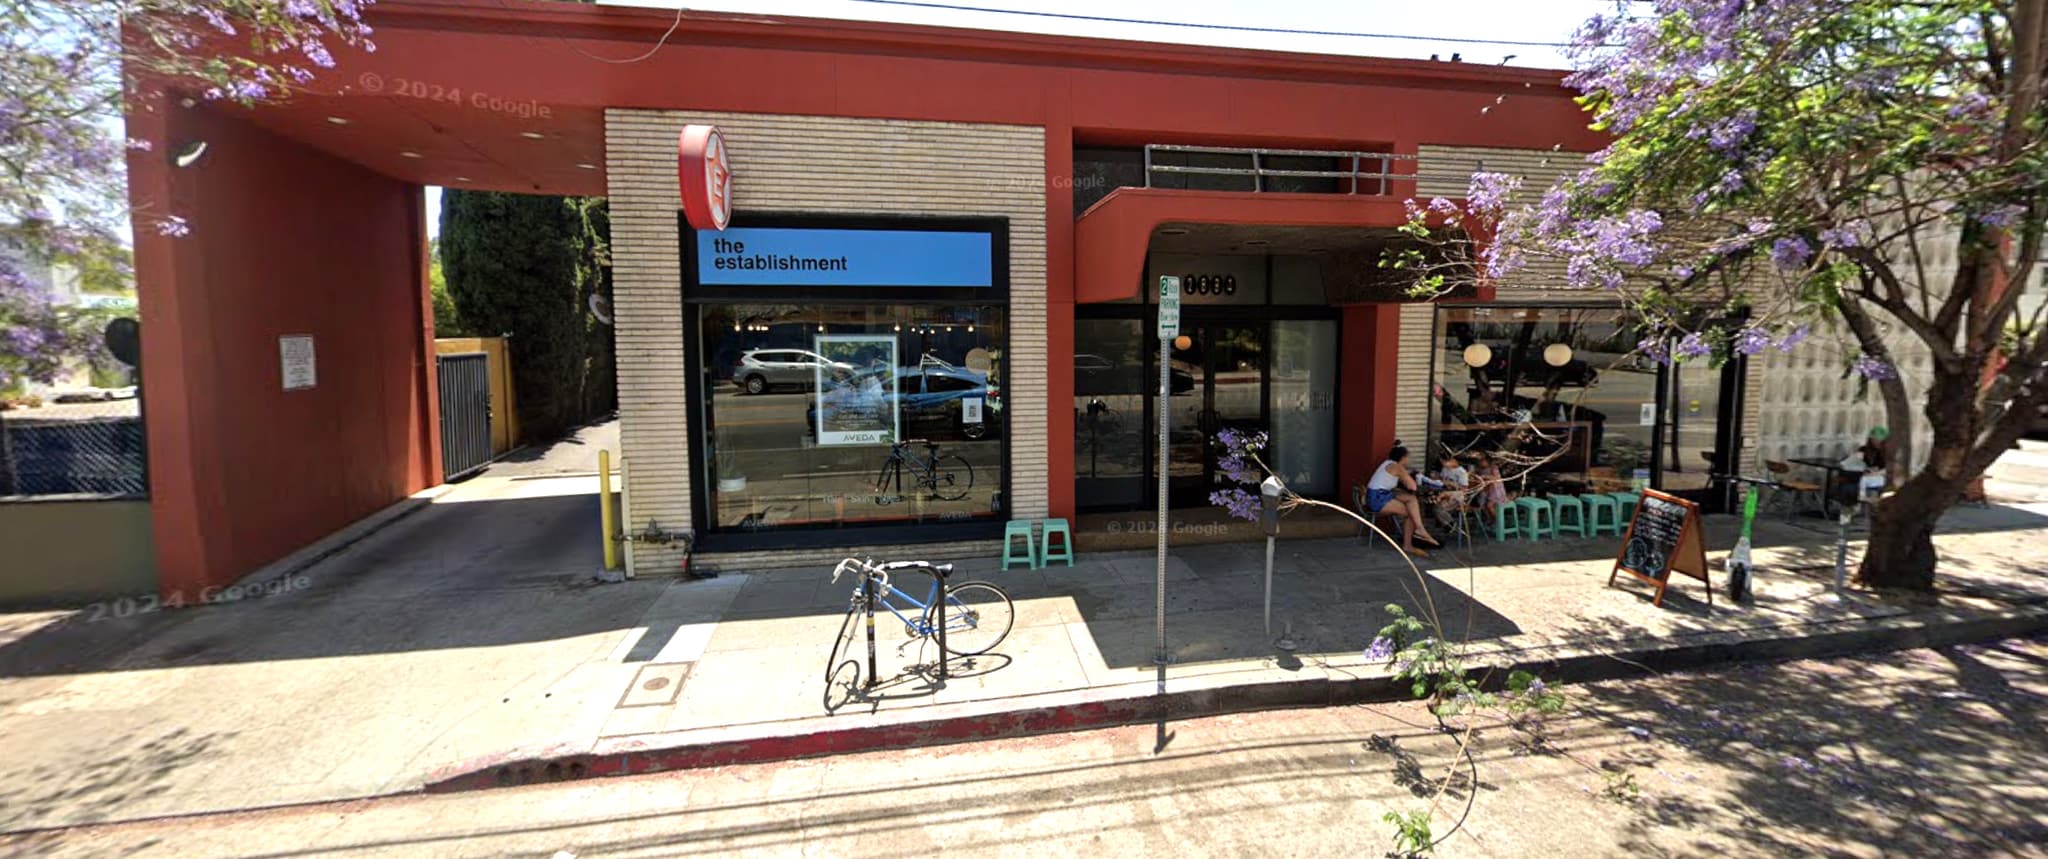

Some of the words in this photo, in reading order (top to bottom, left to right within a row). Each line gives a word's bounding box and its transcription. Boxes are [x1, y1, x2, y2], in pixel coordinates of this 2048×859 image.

[714, 238, 744, 253] the
[714, 254, 847, 270] establishment
[843, 433, 875, 442] AVEDA
